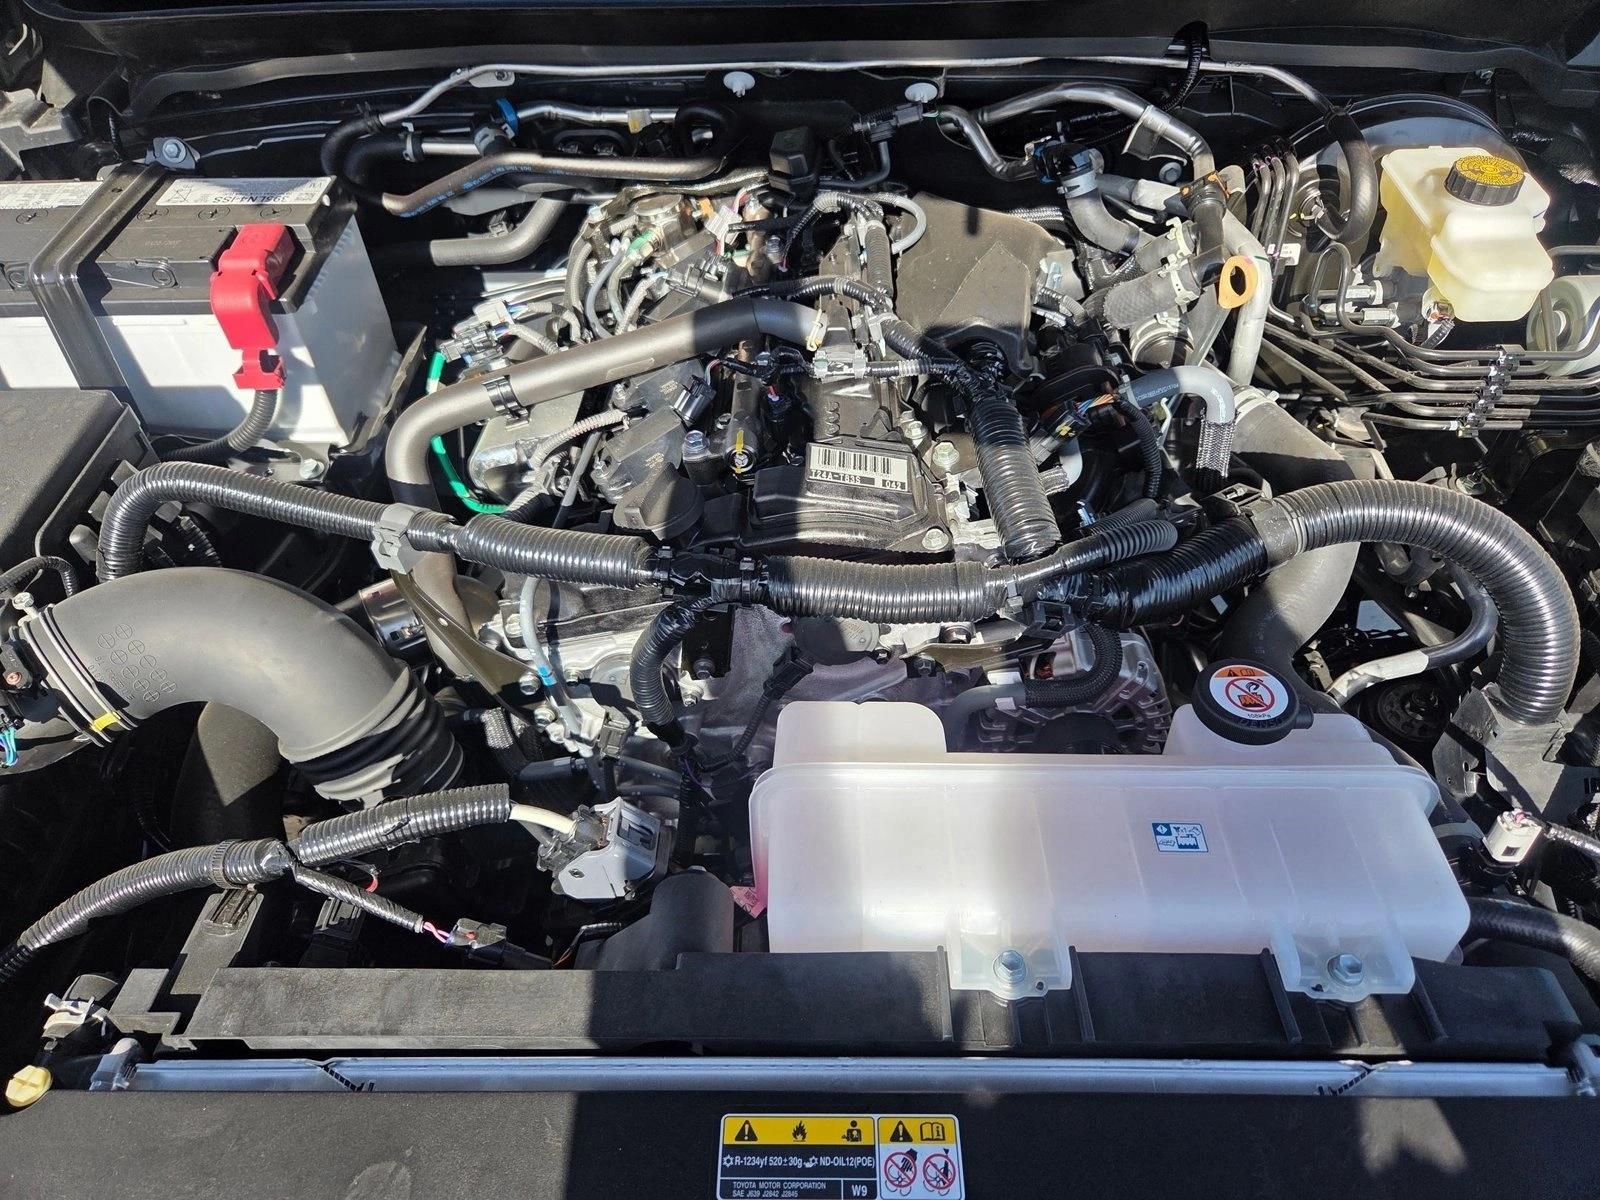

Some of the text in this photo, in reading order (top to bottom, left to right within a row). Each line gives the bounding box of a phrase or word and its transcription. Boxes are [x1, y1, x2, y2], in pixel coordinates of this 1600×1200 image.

[885, 480, 901, 490] 042
[735, 1156, 875, 1168] R-1234yf 520±30g ND-OIL12(POE)
[732, 1190, 744, 1198] SAE
[762, 1190, 779, 1198] J2842
[781, 1190, 798, 1198] J2845
[851, 1184, 868, 1197] W9
